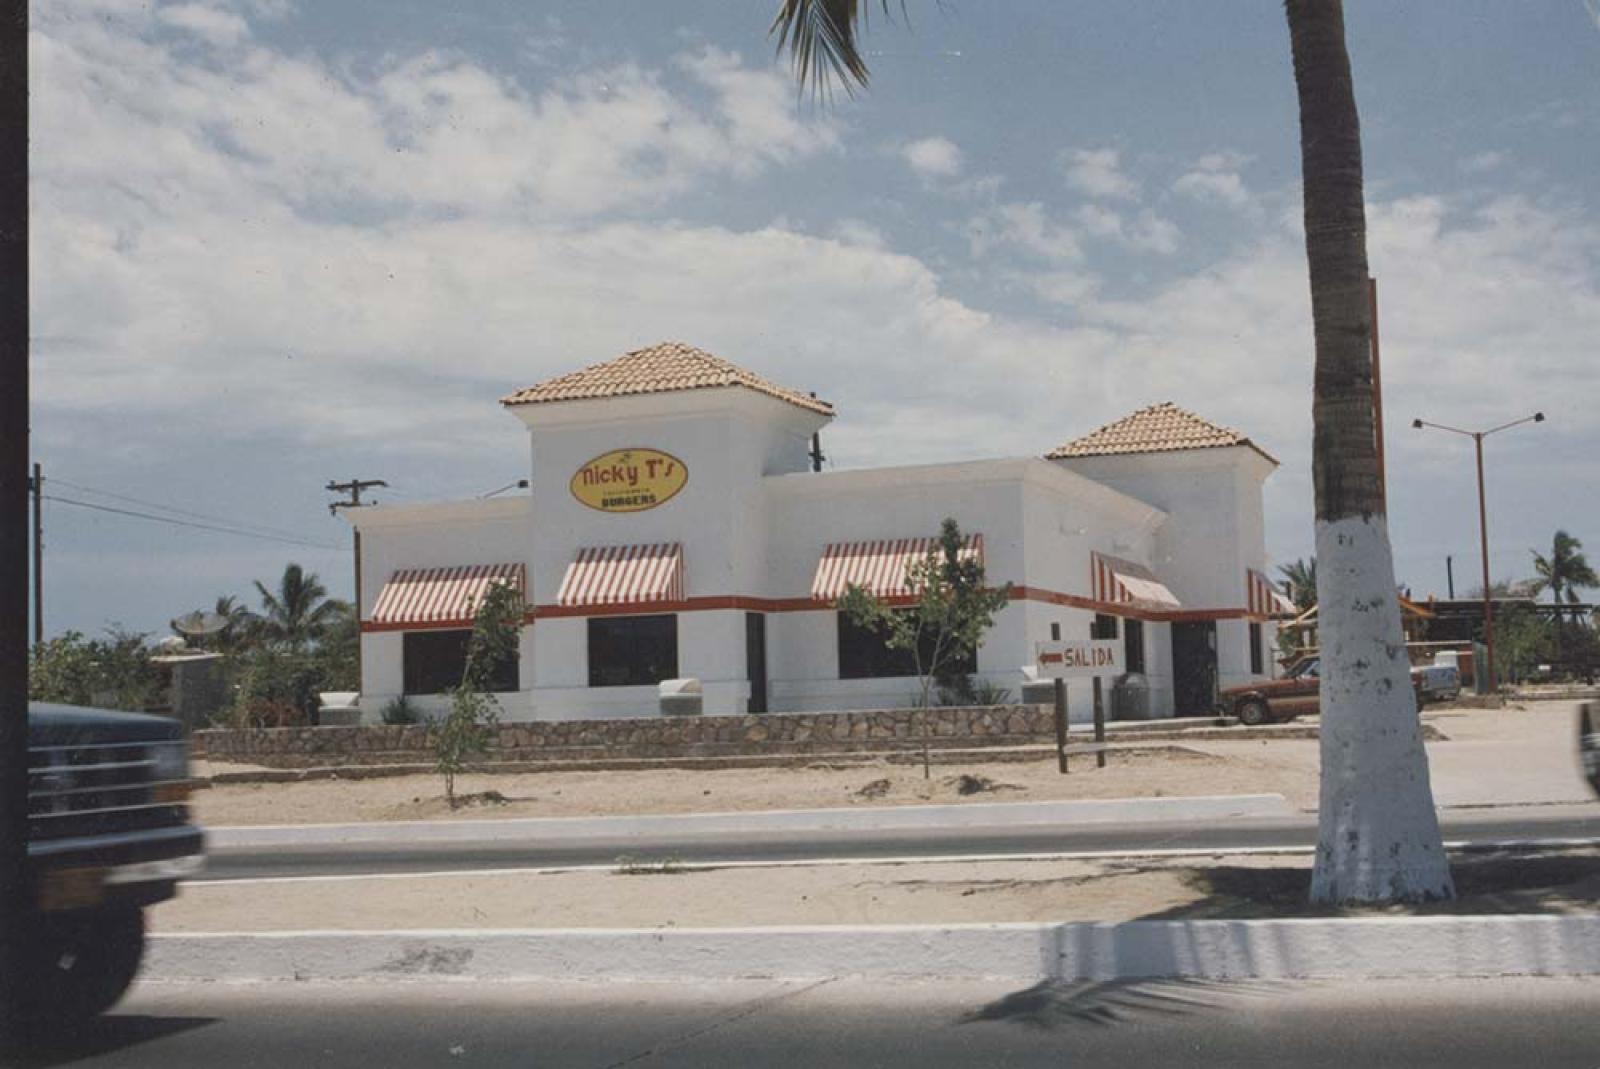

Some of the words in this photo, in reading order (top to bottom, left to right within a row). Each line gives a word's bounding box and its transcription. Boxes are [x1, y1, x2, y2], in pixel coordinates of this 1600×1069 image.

[645, 459, 674, 479] T's
[601, 494, 657, 507] BURGERS
[1064, 647, 1114, 667] SALIDA
